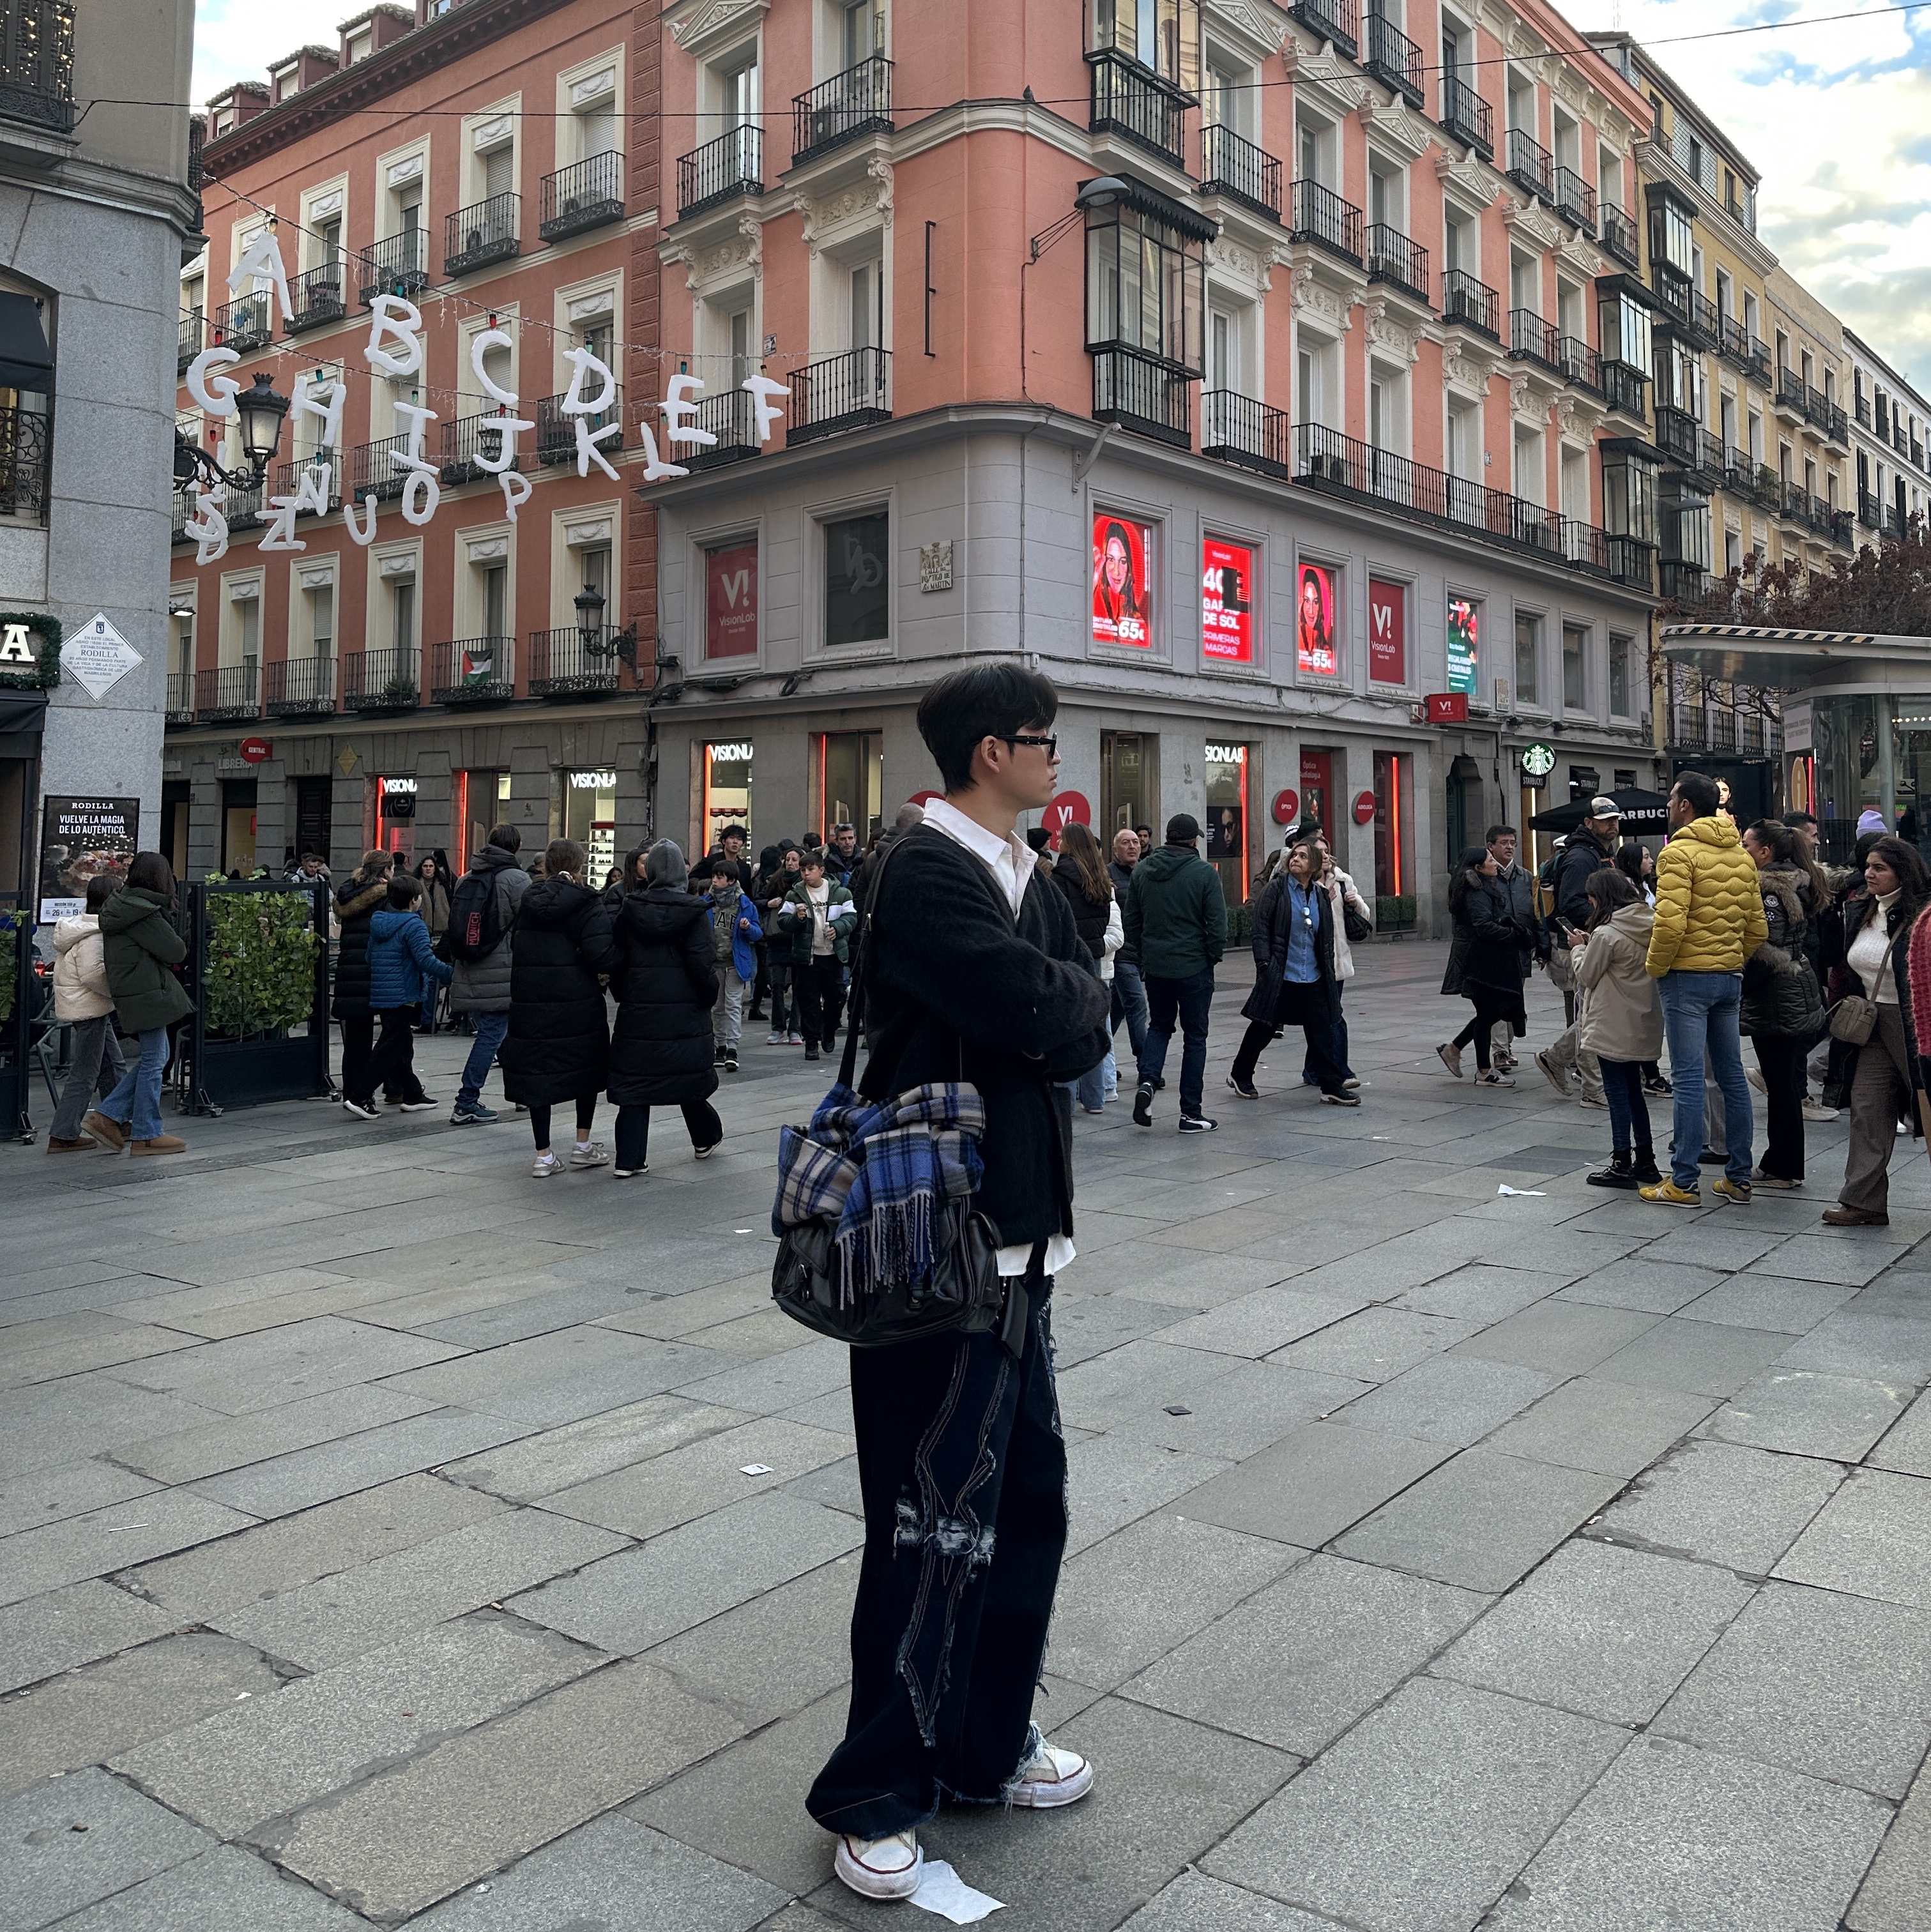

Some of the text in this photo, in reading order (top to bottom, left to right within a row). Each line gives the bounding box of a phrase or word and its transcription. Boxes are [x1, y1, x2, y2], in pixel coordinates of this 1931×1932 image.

[226, 232, 791, 445] A B C D E F
[290, 375, 346, 447] H
[473, 417, 535, 473] J
[575, 418, 621, 481] K
[922, 574, 942, 583] POSTIGO
[719, 612, 755, 627] VisionLab
[1203, 611, 1240, 630] DE SOL
[0, 624, 34, 662] A
[1205, 643, 1237, 656] MARCAS
[1371, 641, 1396, 653] VisionLab
[81, 650, 118, 658] RODILLA
[59, 814, 125, 824] VUELVE LA MAGIA
[59, 825, 70, 834] DE
[71, 825, 80, 834] LO
[469, 913, 479, 945] MUNICH
